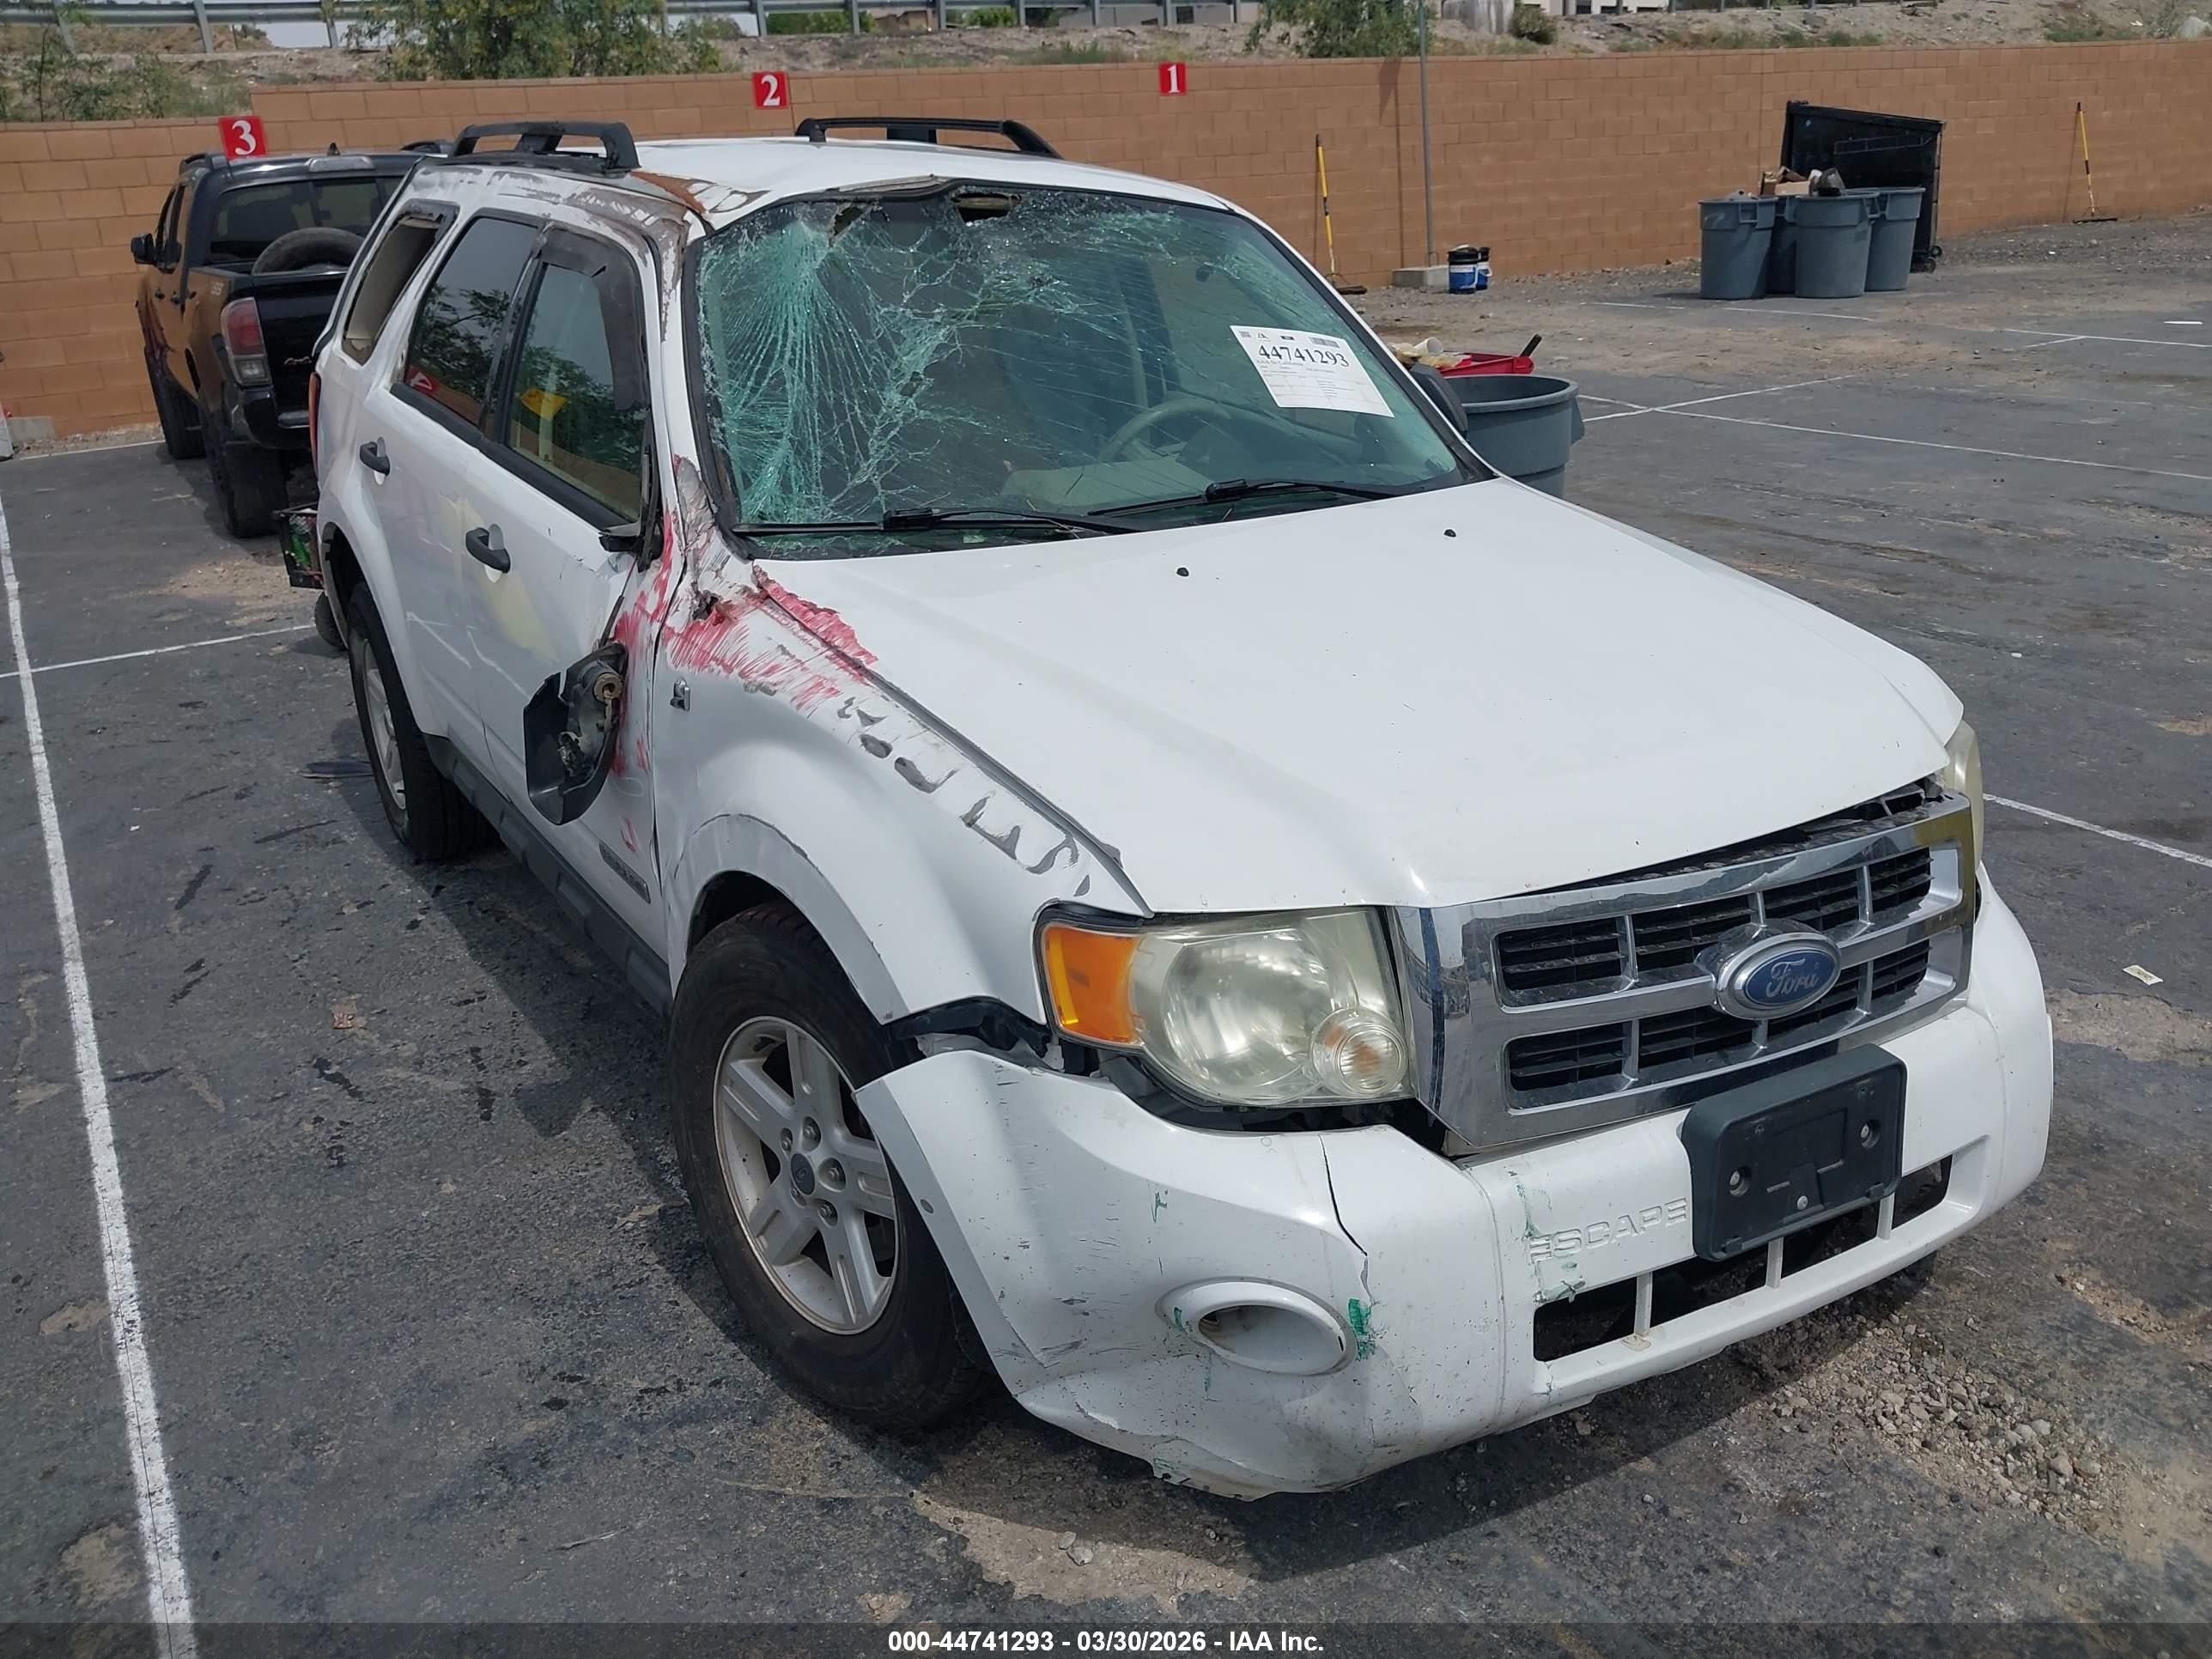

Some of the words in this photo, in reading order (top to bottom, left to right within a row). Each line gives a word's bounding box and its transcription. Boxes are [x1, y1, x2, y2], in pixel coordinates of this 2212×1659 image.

[761, 75, 781, 106] 2
[1166, 65, 1180, 94] 1
[232, 120, 257, 155] 3
[1258, 344, 1350, 368] 44741293
[1765, 957, 1820, 998] Ford
[1528, 1197, 1688, 1265] ESCAPE
